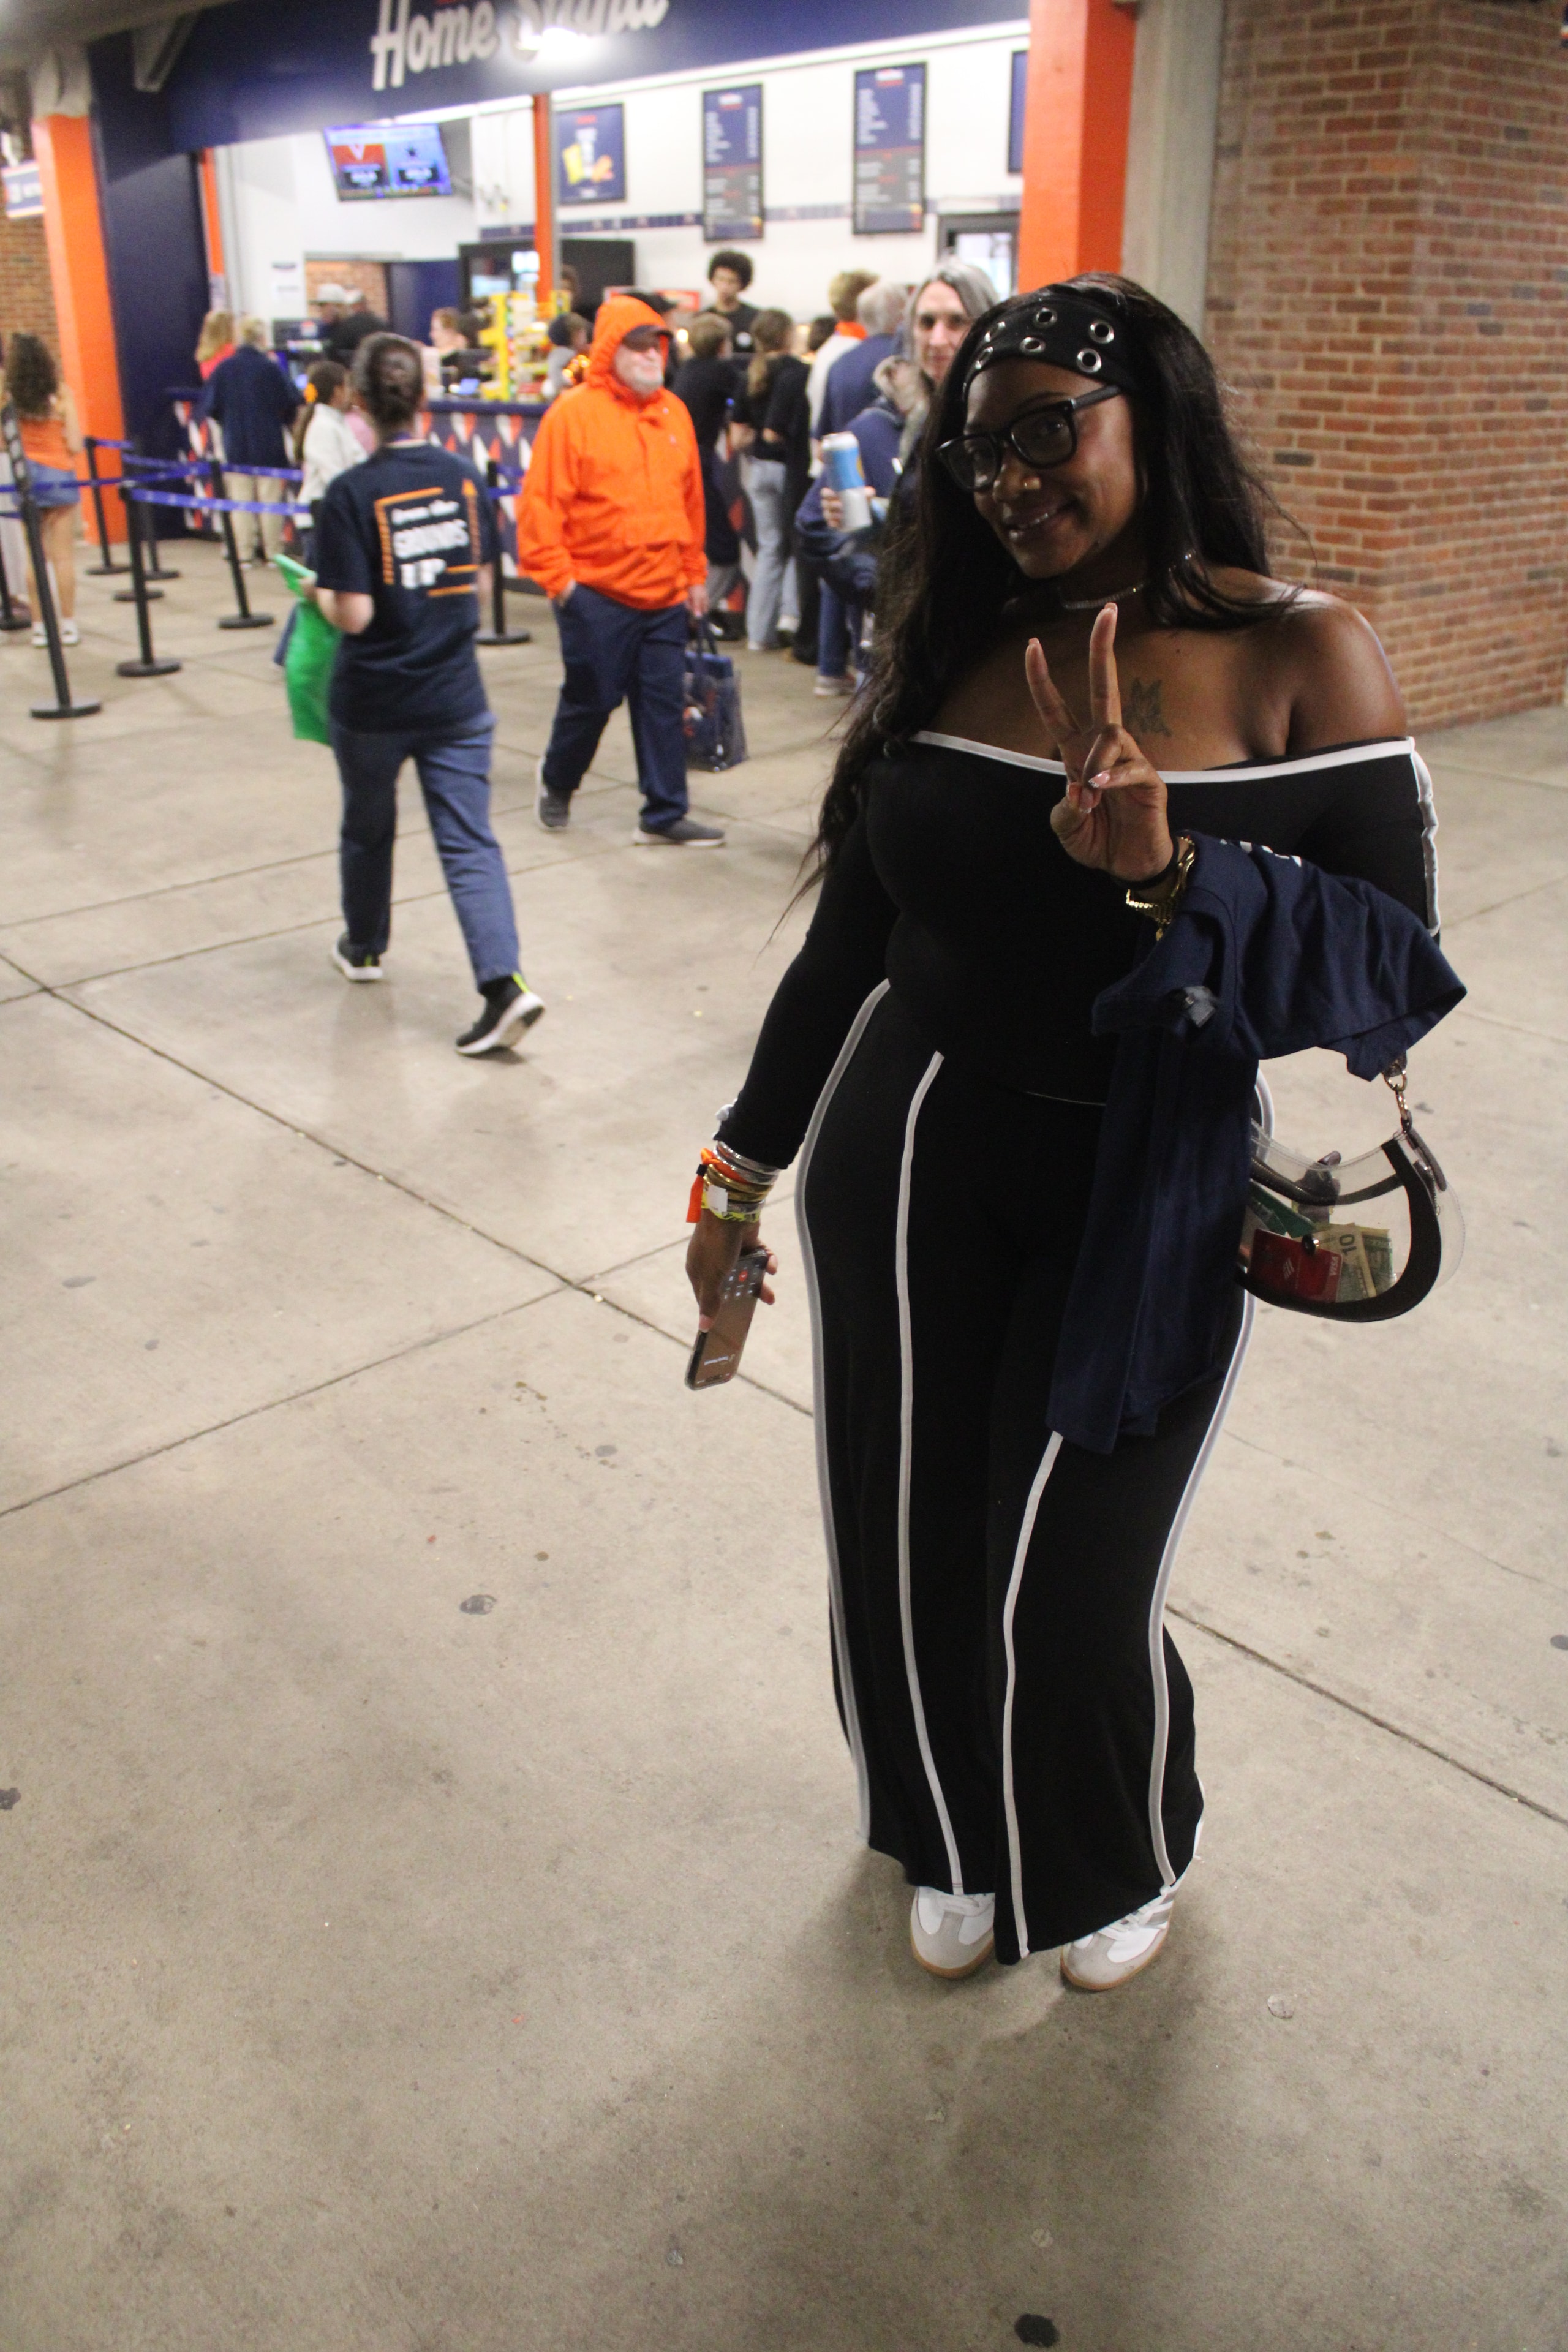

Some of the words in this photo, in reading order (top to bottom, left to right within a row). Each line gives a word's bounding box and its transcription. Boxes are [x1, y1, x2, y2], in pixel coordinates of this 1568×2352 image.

[370, 0, 500, 91] Home
[1340, 1234, 1357, 1255] 10
[1329, 1256, 1339, 1276] VISA
